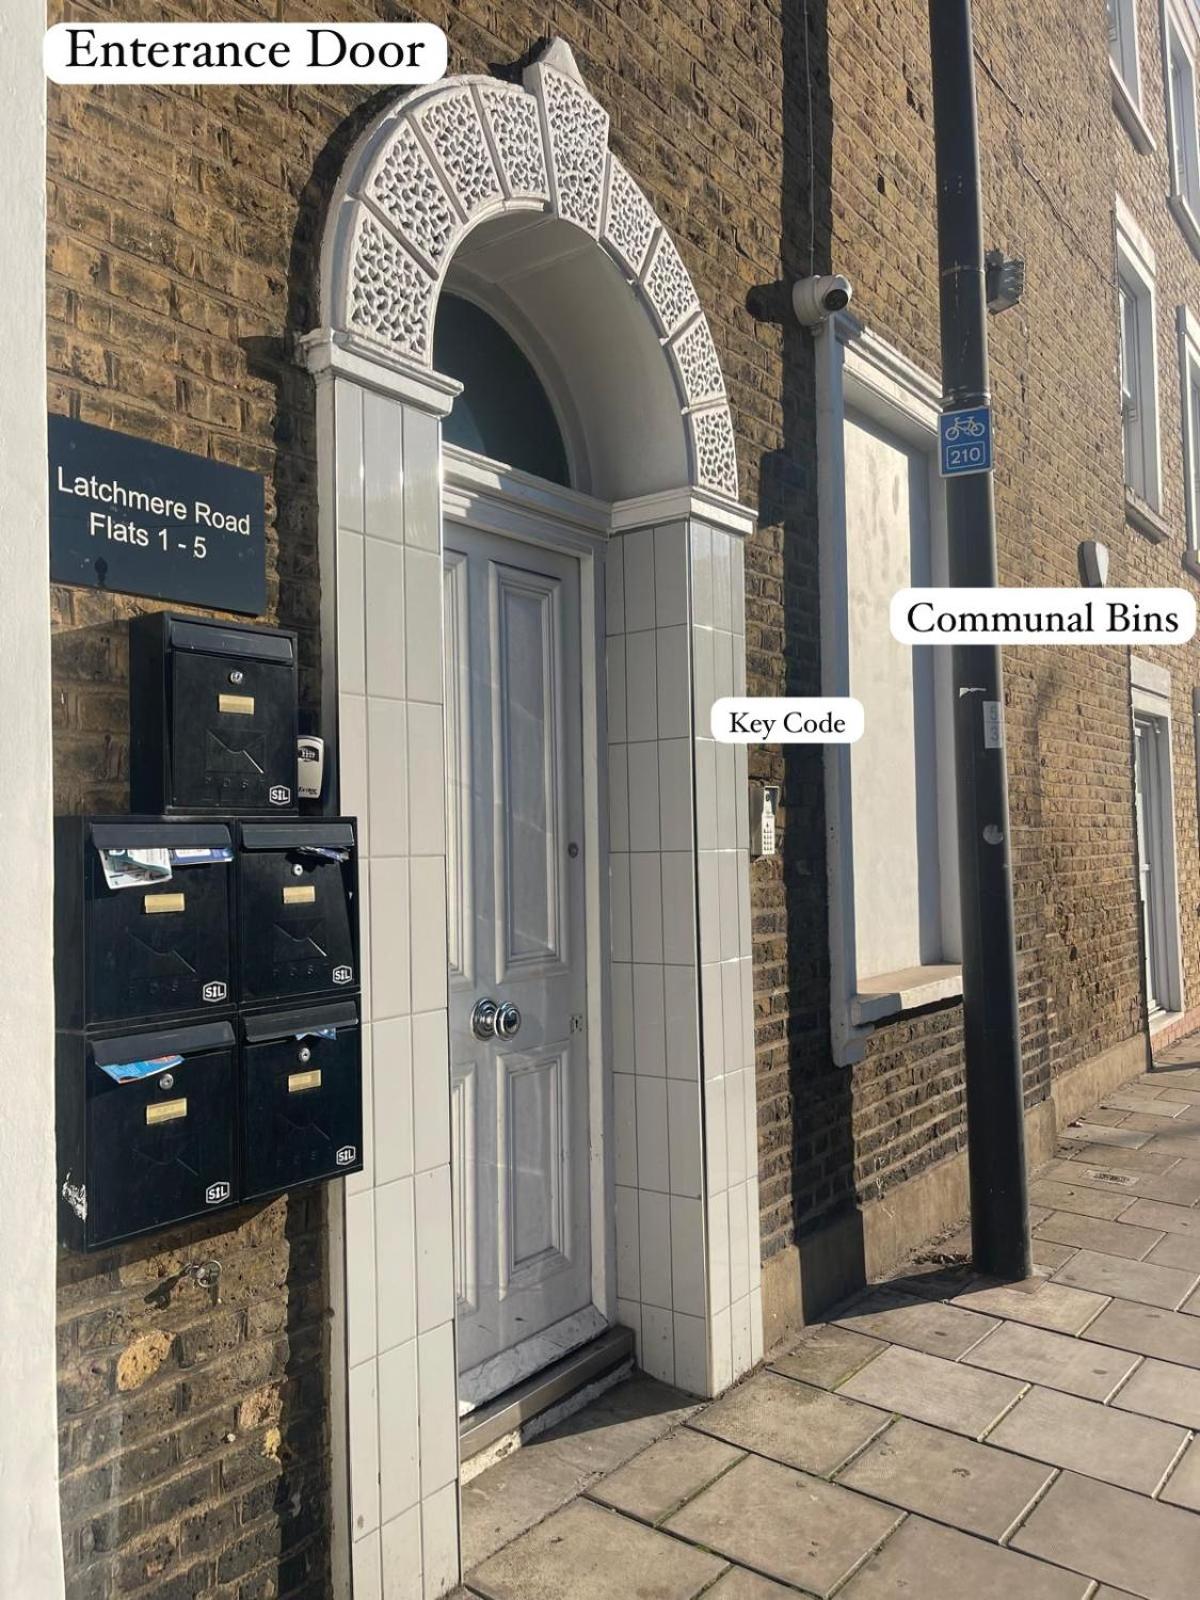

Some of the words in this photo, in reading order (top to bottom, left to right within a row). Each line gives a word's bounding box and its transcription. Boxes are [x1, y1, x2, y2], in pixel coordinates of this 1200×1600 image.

[950, 447, 981, 465] 210
[57, 465, 188, 520] Latchmere
[194, 501, 251, 536] Road
[89, 511, 150, 547] Flats
[158, 528, 169, 551] 1
[193, 535, 207, 559] 5
[271, 789, 289, 801] SIL
[335, 969, 351, 981] SIL
[205, 985, 225, 998] SIL
[338, 1149, 354, 1162] SIL
[208, 1185, 228, 1200] SIL
